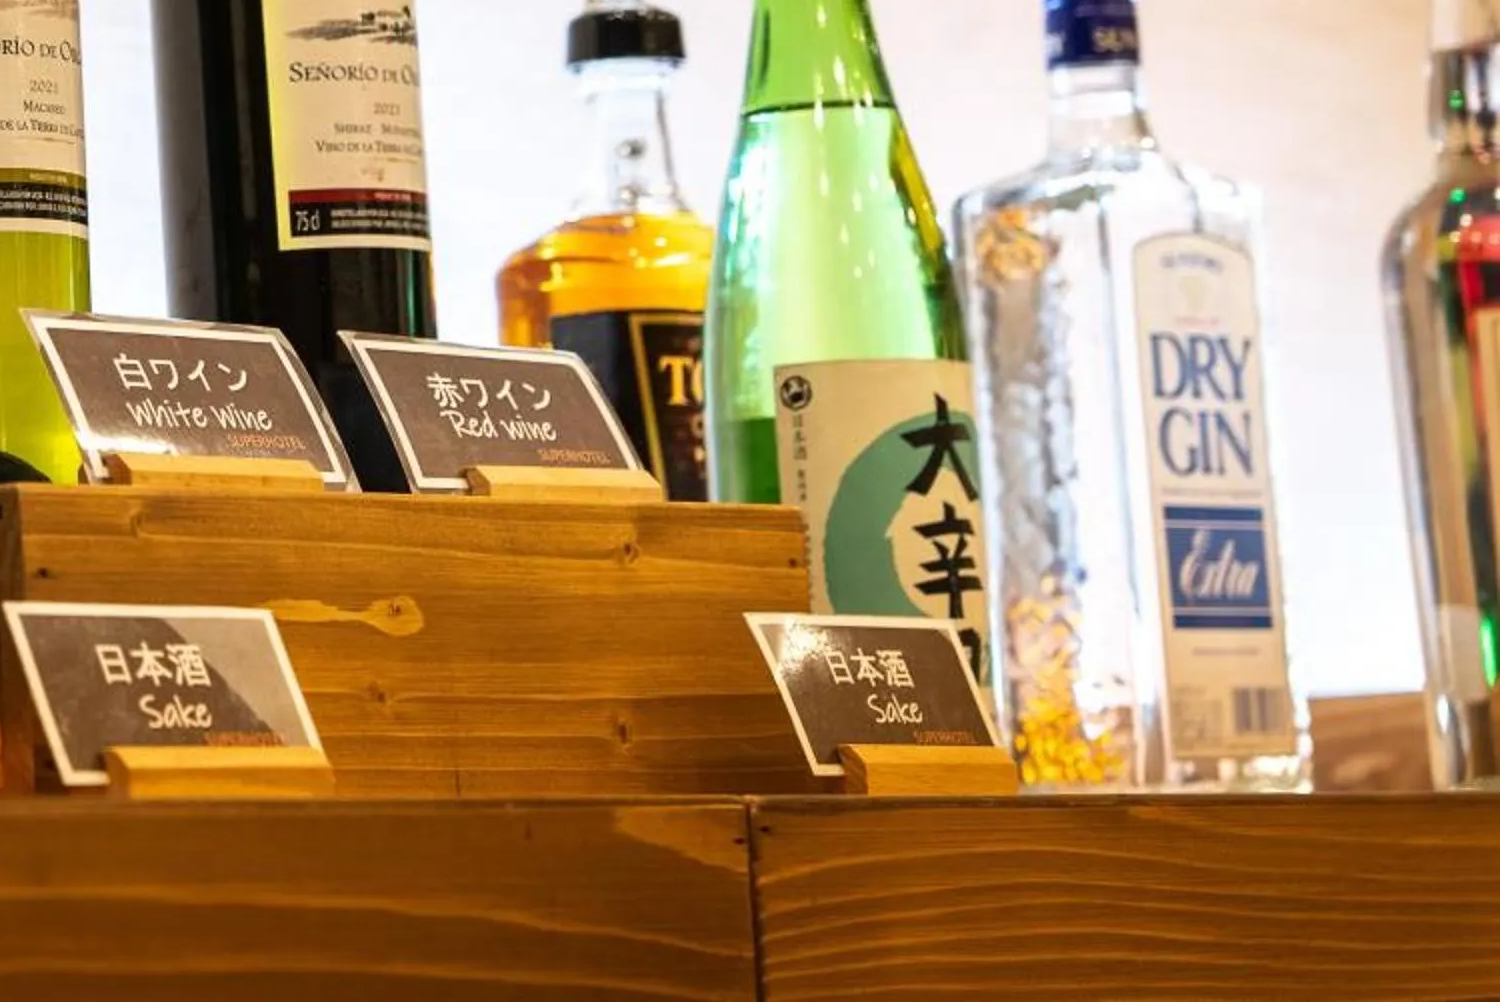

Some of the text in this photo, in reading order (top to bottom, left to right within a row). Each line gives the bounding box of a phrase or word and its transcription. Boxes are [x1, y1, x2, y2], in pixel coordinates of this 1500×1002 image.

[39, 43, 58, 58] DE
[112, 352, 248, 392] 白ワイン
[1150, 332, 1250, 401] DRY
[426, 371, 551, 411] 赤ワイン
[125, 398, 208, 428] White
[439, 409, 499, 439] Red
[1158, 406, 1253, 477] GIN
[94, 639, 212, 688] 日本酒
[825, 647, 916, 689] 日本酒
[137, 693, 213, 729] Sake
[866, 693, 924, 724] Sake
